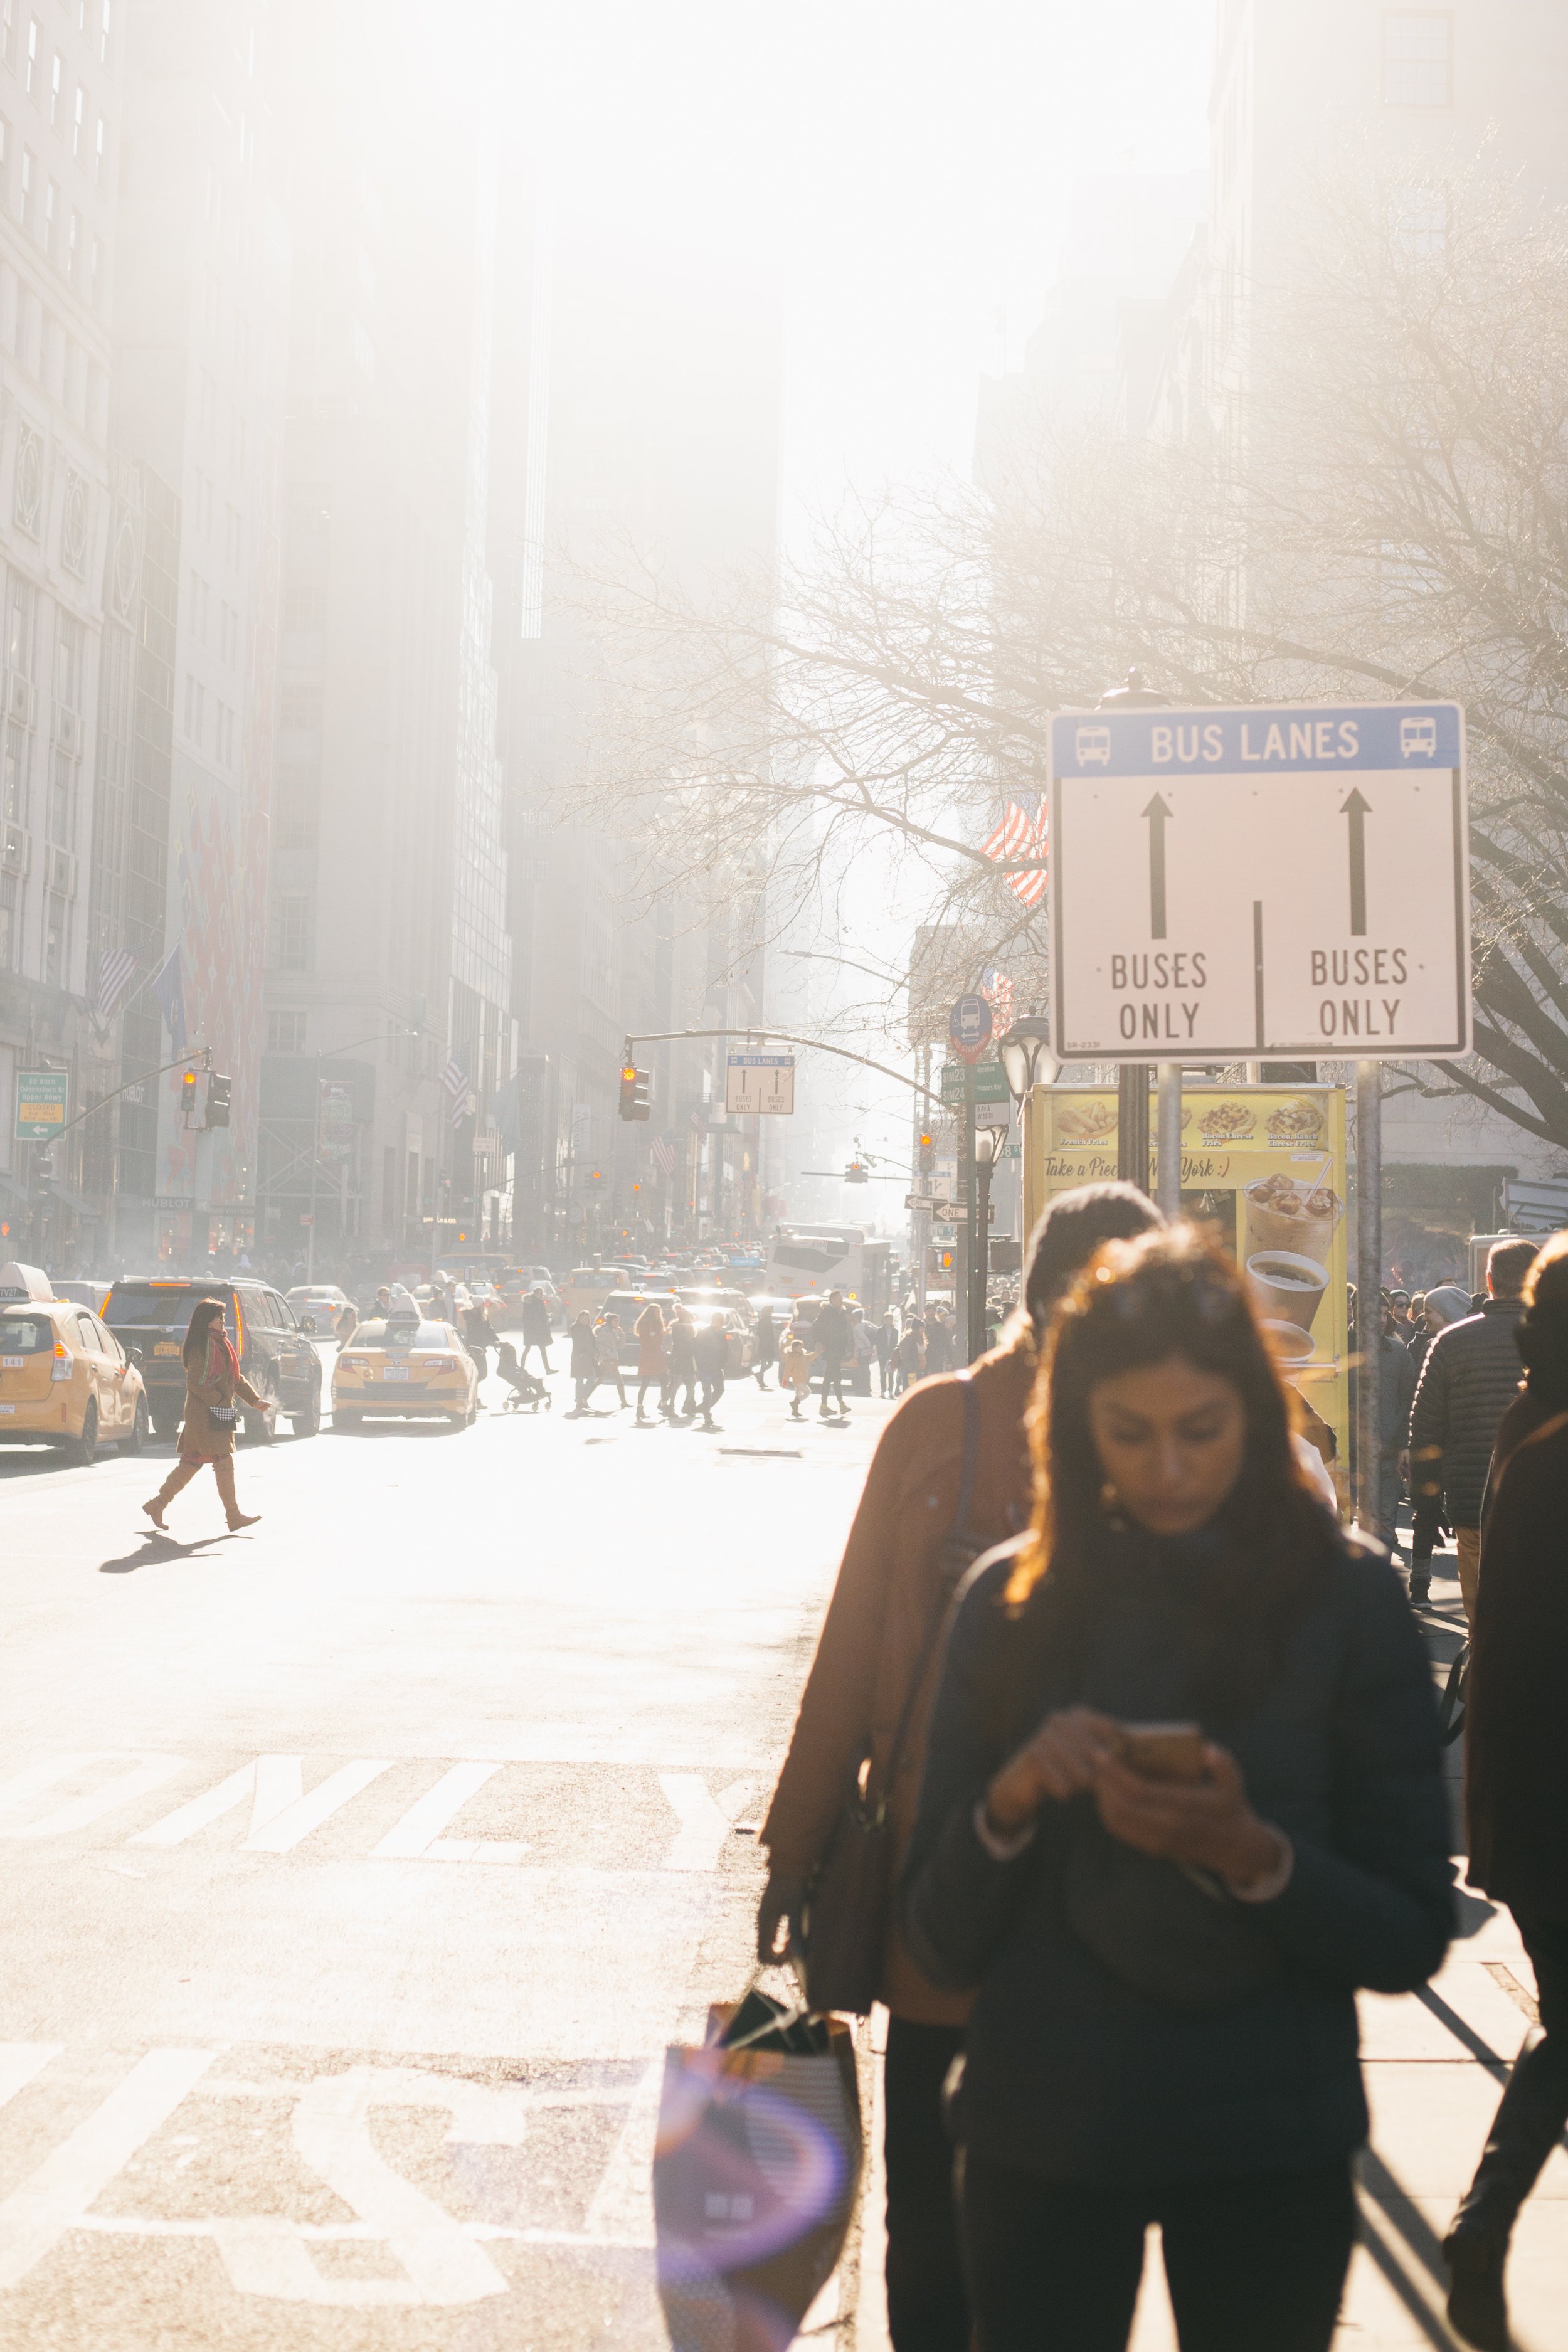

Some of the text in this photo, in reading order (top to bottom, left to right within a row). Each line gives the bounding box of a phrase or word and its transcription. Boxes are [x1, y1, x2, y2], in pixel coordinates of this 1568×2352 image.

[1152, 721, 1360, 763] BUS LANES
[1111, 952, 1207, 990] BUSES
[1311, 948, 1408, 986] BUSES
[1119, 1002, 1200, 1039] ONLY
[1320, 999, 1401, 1036] ONLY
[953, 1035, 987, 1053] NO STANDING
[943, 1069, 965, 1083] SIM23
[943, 1087, 965, 1102] SIM24
[1044, 1157, 1074, 1177] Take
[1078, 1165, 1087, 1177] a
[1089, 1157, 1118, 1177] Piec
[1180, 1157, 1214, 1183] York
[142, 1198, 190, 1209] HUBLOT
[942, 1209, 959, 1217] ONE
[938, 1227, 957, 1235] W 58
[0, 1288, 17, 1296] 7V27
[4, 1359, 21, 1367] 141
[0, 1754, 761, 1872] ONLY
